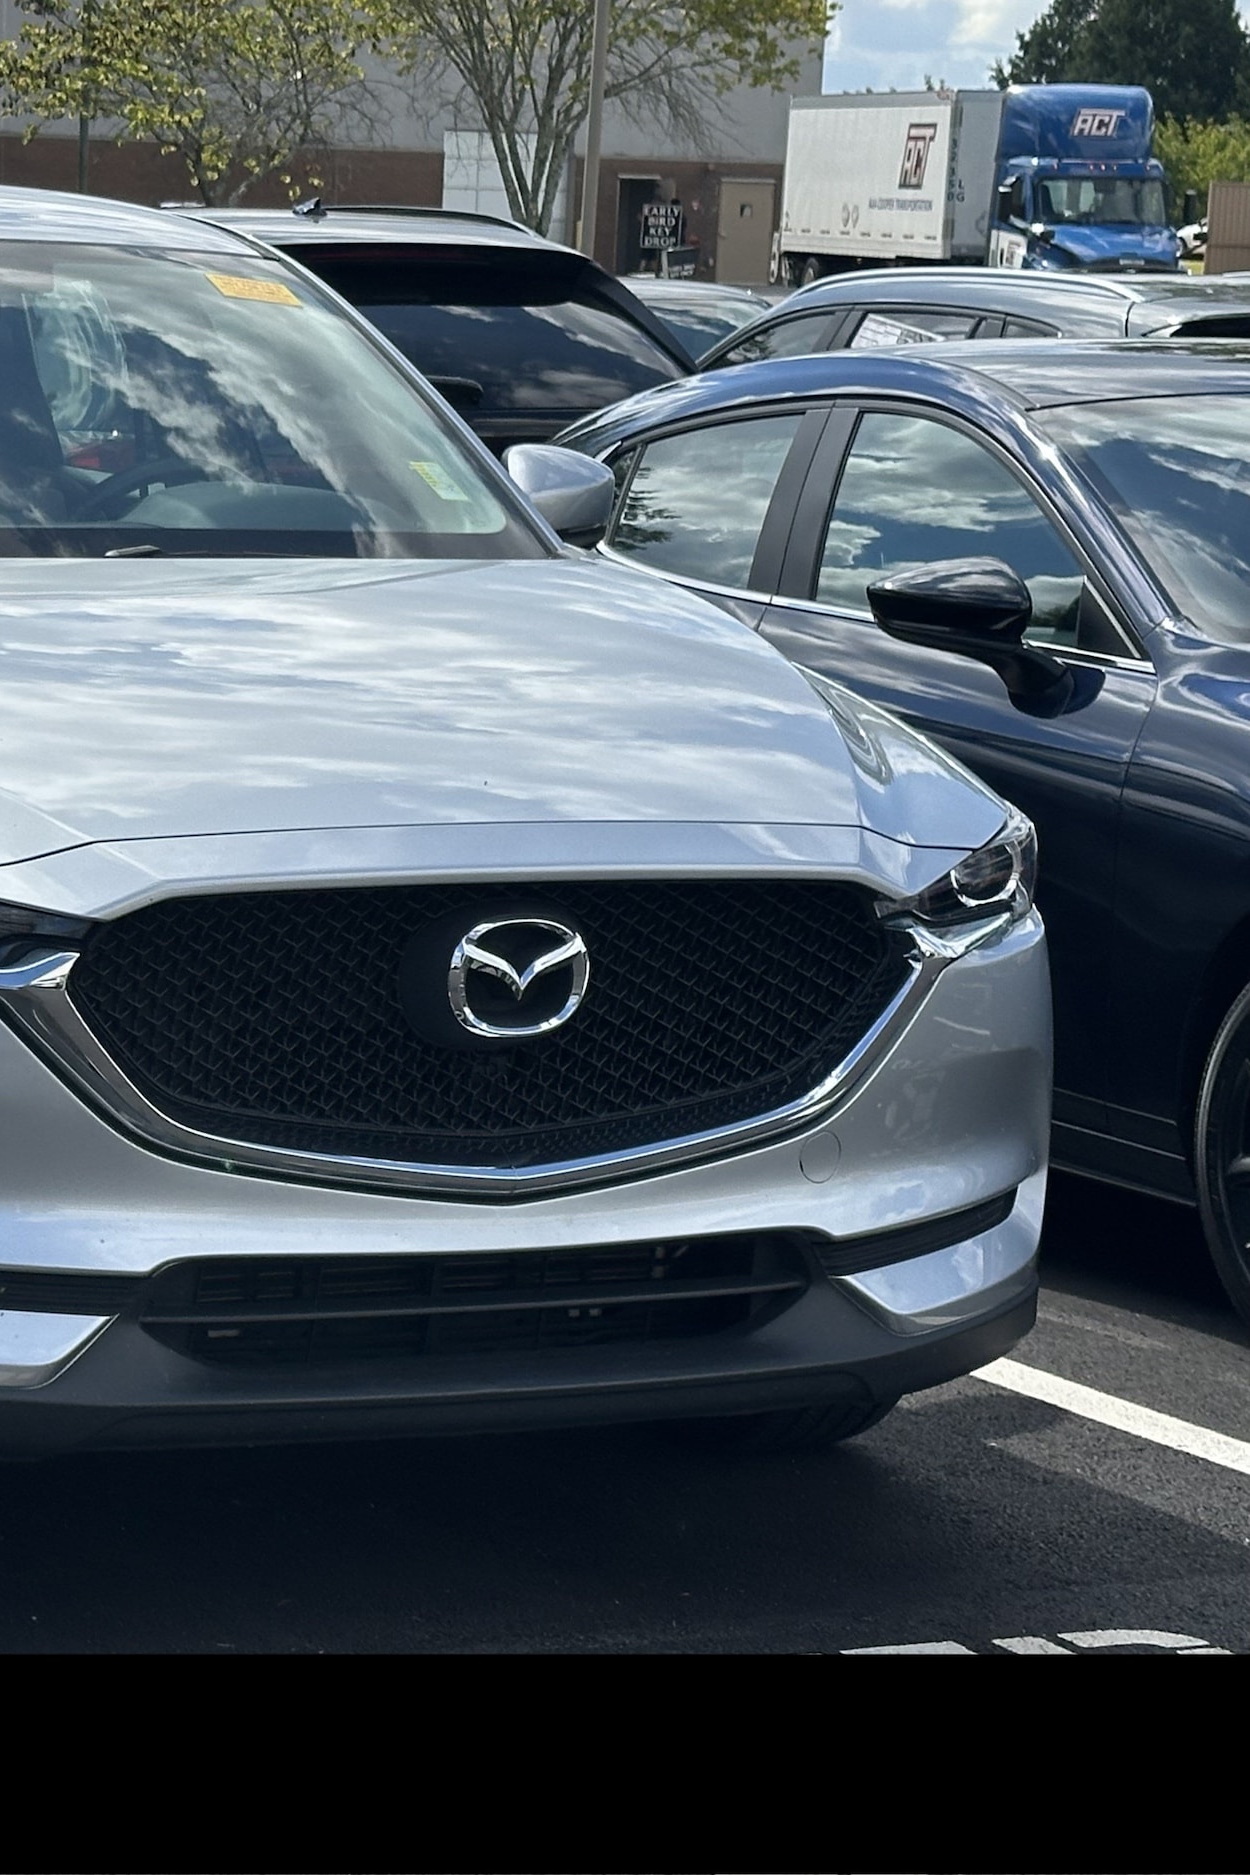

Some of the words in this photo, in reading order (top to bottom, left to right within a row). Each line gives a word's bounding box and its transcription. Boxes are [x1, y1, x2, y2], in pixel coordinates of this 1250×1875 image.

[1071, 108, 1126, 138] ACT
[899, 122, 937, 190] ACT
[643, 206, 680, 217] EARLY
[648, 216, 676, 227] BIRD
[649, 226, 671, 236] KEY
[644, 236, 677, 247] DROP
